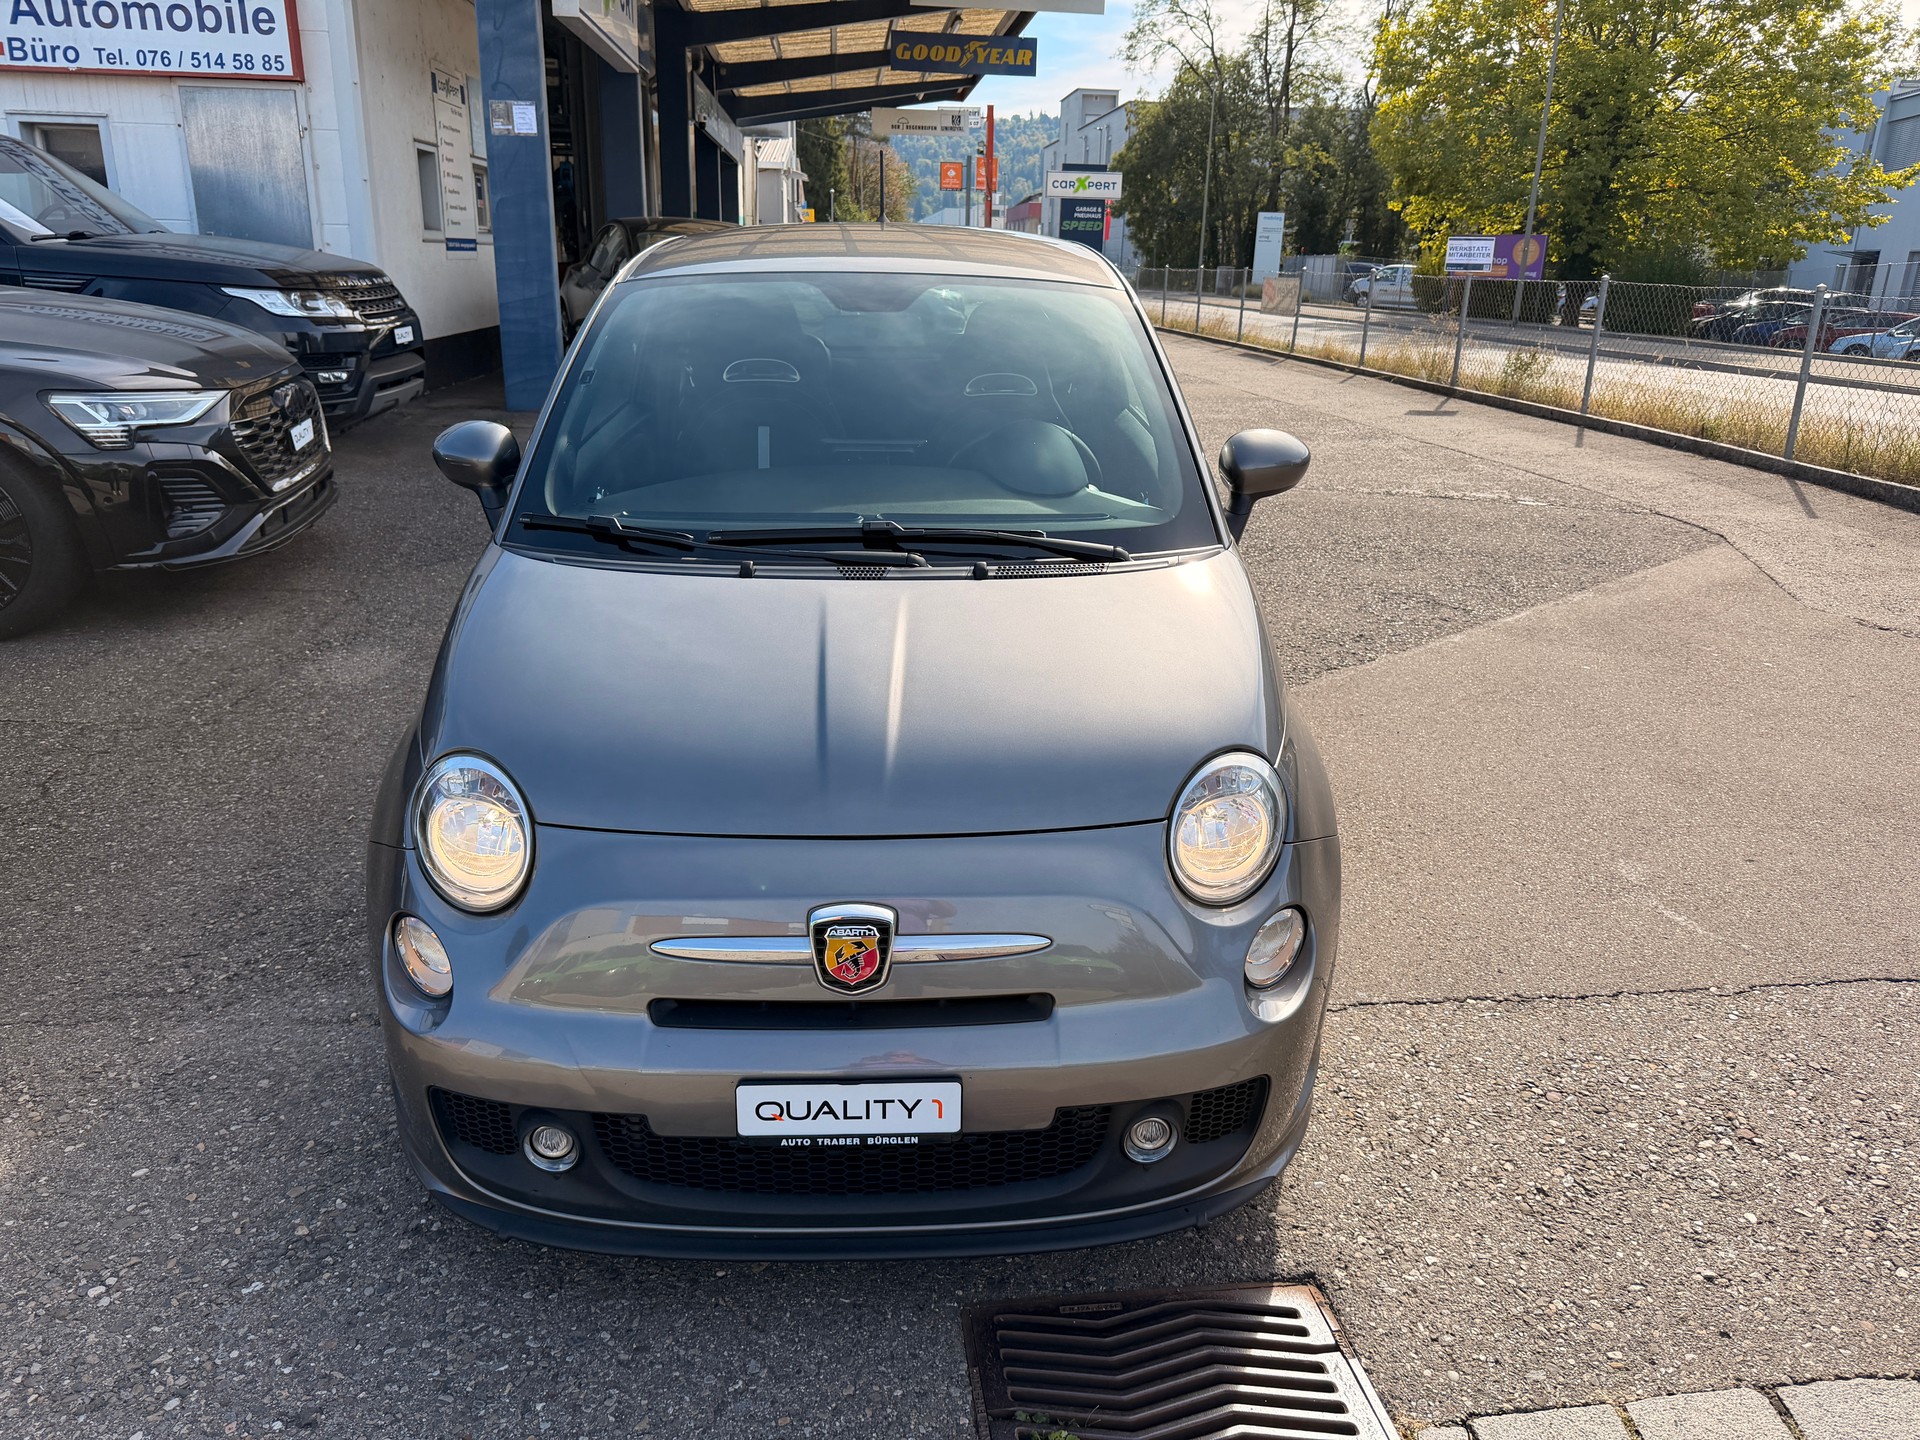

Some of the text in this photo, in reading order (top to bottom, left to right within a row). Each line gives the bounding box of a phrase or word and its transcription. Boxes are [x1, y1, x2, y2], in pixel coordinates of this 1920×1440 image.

[9, 0, 276, 35] Automobile
[6, 36, 80, 63] Büro
[93, 47, 129, 65] Tel.
[136, 49, 172, 68] 076
[190, 51, 226, 69] 514
[232, 53, 255, 70] 58
[261, 54, 285, 71] 85
[895, 41, 1033, 66] GOODYEAR
[1061, 220, 1103, 231] SPEED
[755, 1099, 922, 1121] QUALITY
[780, 1136, 919, 1146] AUTO TRABER BÜRGLEN
